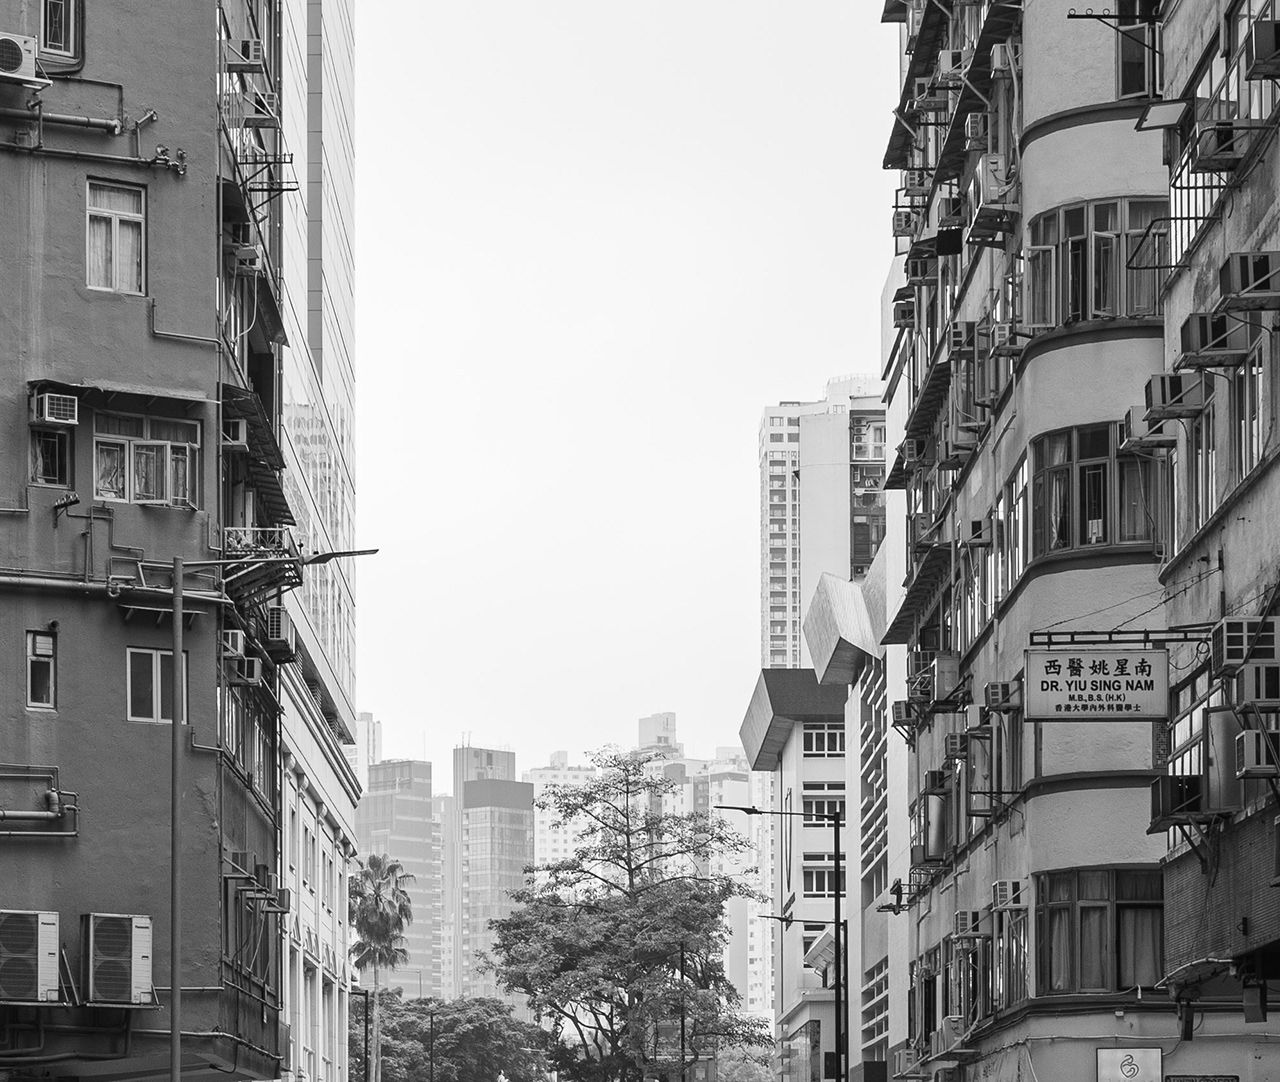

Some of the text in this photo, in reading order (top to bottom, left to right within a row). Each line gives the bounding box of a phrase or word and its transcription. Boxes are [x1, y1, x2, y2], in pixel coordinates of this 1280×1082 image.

[1044, 657, 1152, 678] 西醫姚星南
[1040, 679, 1154, 692] DR. YIU SING NAM
